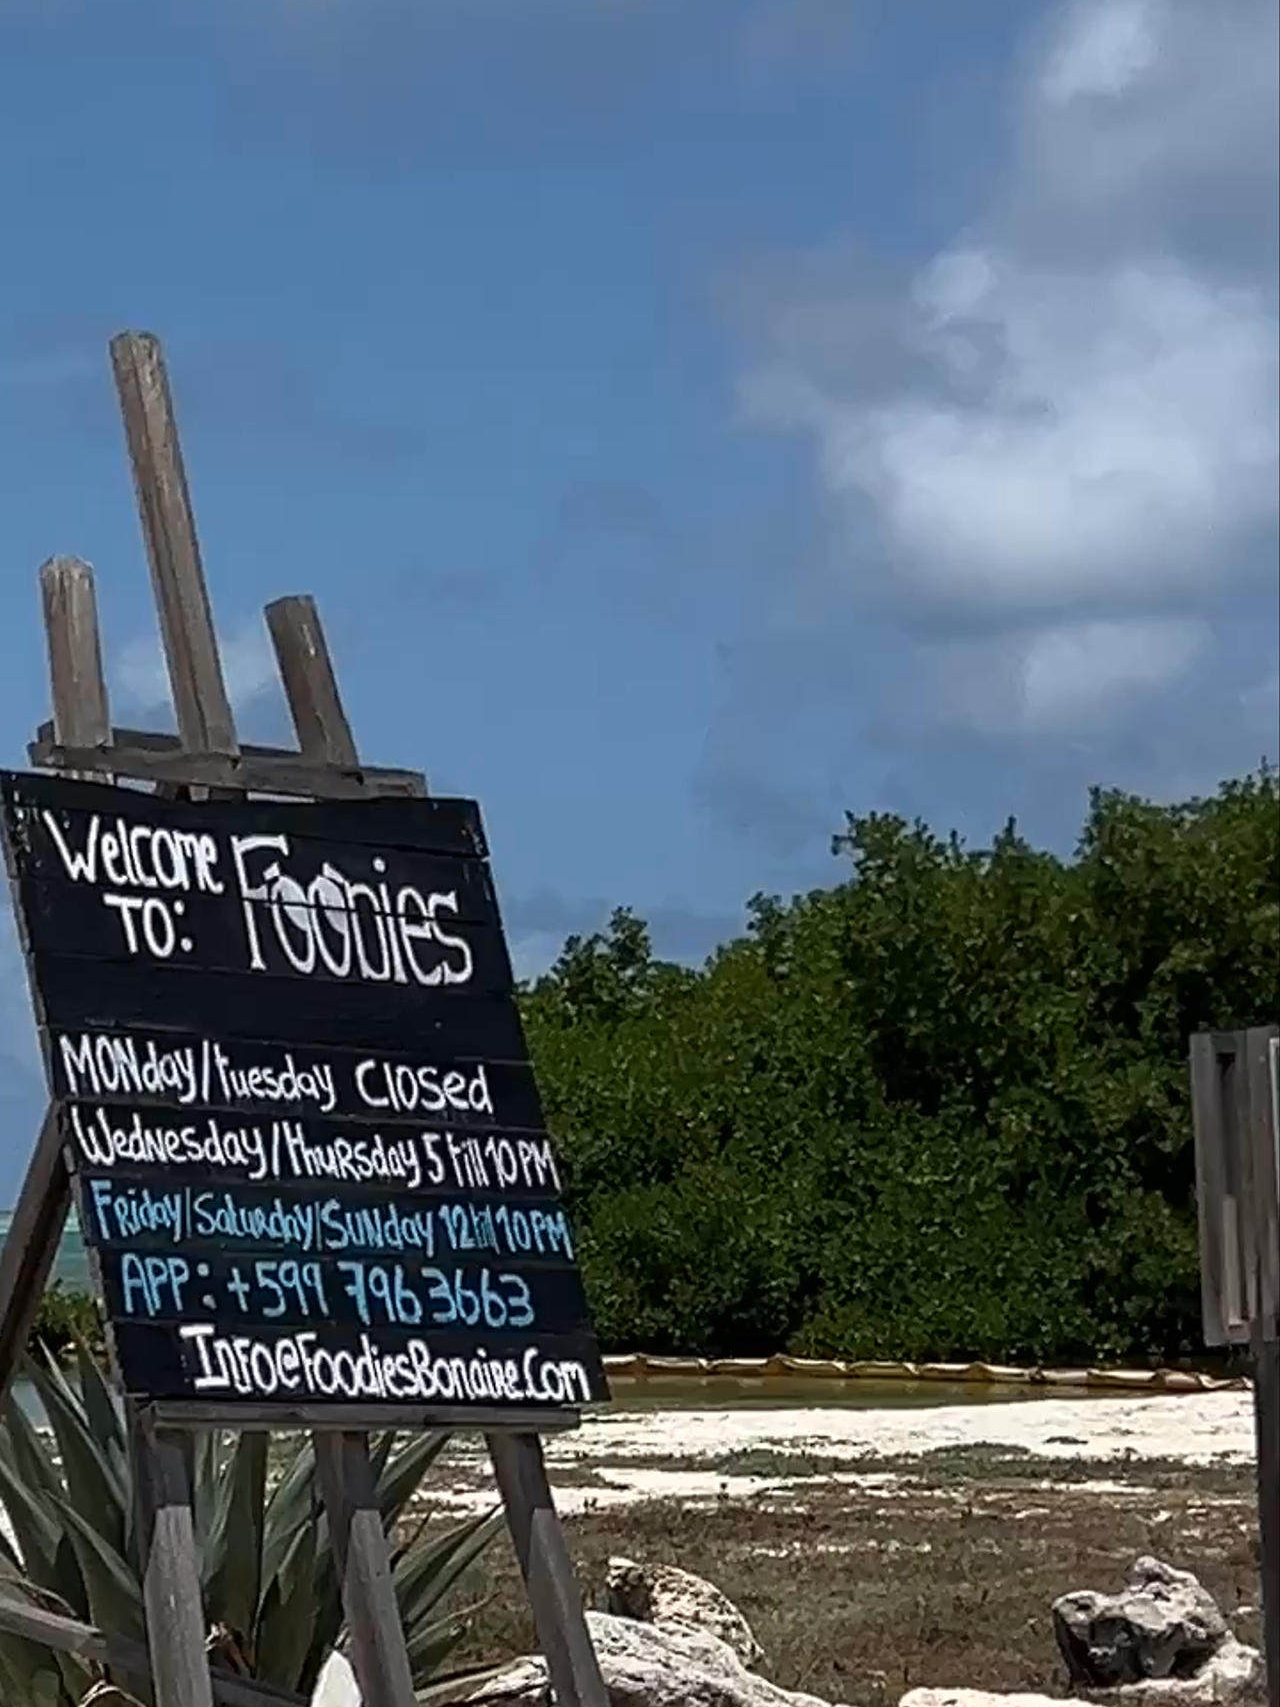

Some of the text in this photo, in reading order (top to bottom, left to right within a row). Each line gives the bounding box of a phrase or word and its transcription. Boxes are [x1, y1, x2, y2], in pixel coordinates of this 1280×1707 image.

[43, 809, 225, 893] Welcome
[421, 1132, 445, 1185] 5
[227, 1259, 330, 1318] +599
